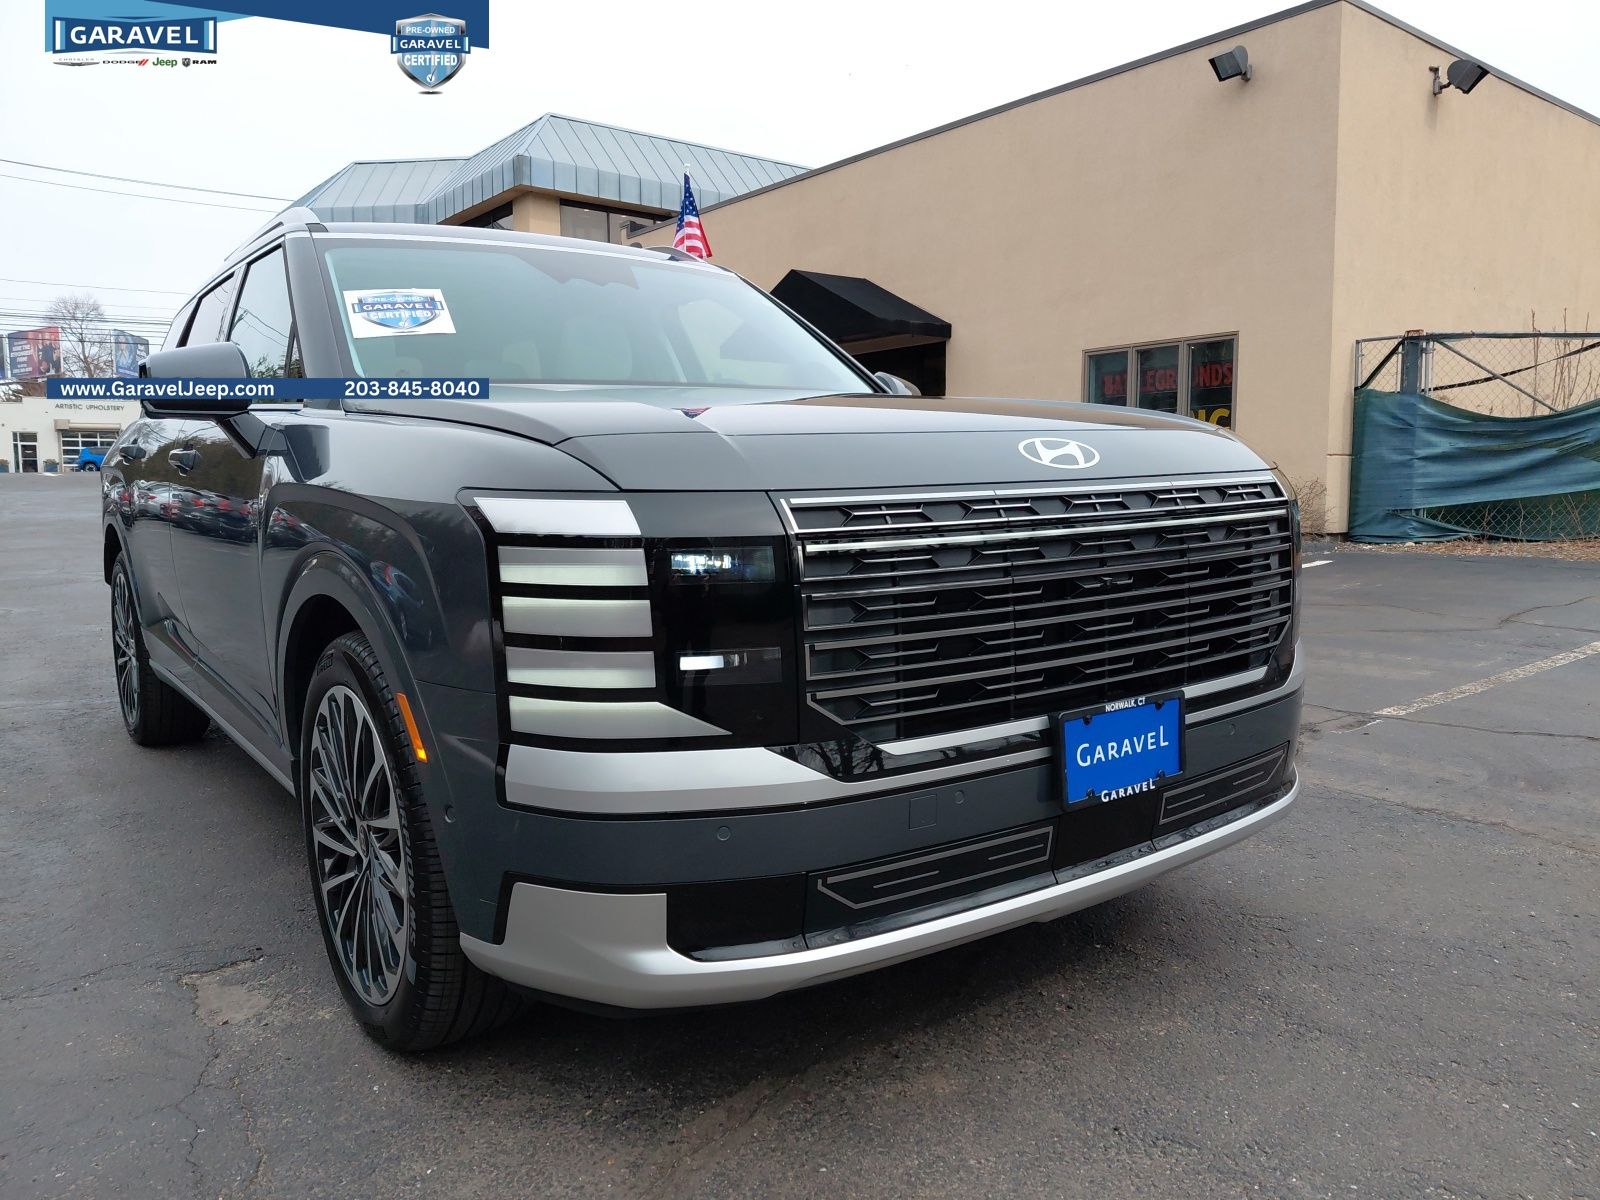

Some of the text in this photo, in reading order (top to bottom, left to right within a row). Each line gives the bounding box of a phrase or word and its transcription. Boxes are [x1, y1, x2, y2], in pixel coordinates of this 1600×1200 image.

[363, 302, 433, 310] GARAVEL
[370, 310, 432, 319] CERTIFIED
[1105, 697, 1146, 712] NORWALK, CT
[1076, 725, 1169, 767] GARAVEL
[1101, 778, 1156, 802] GARAVEL
